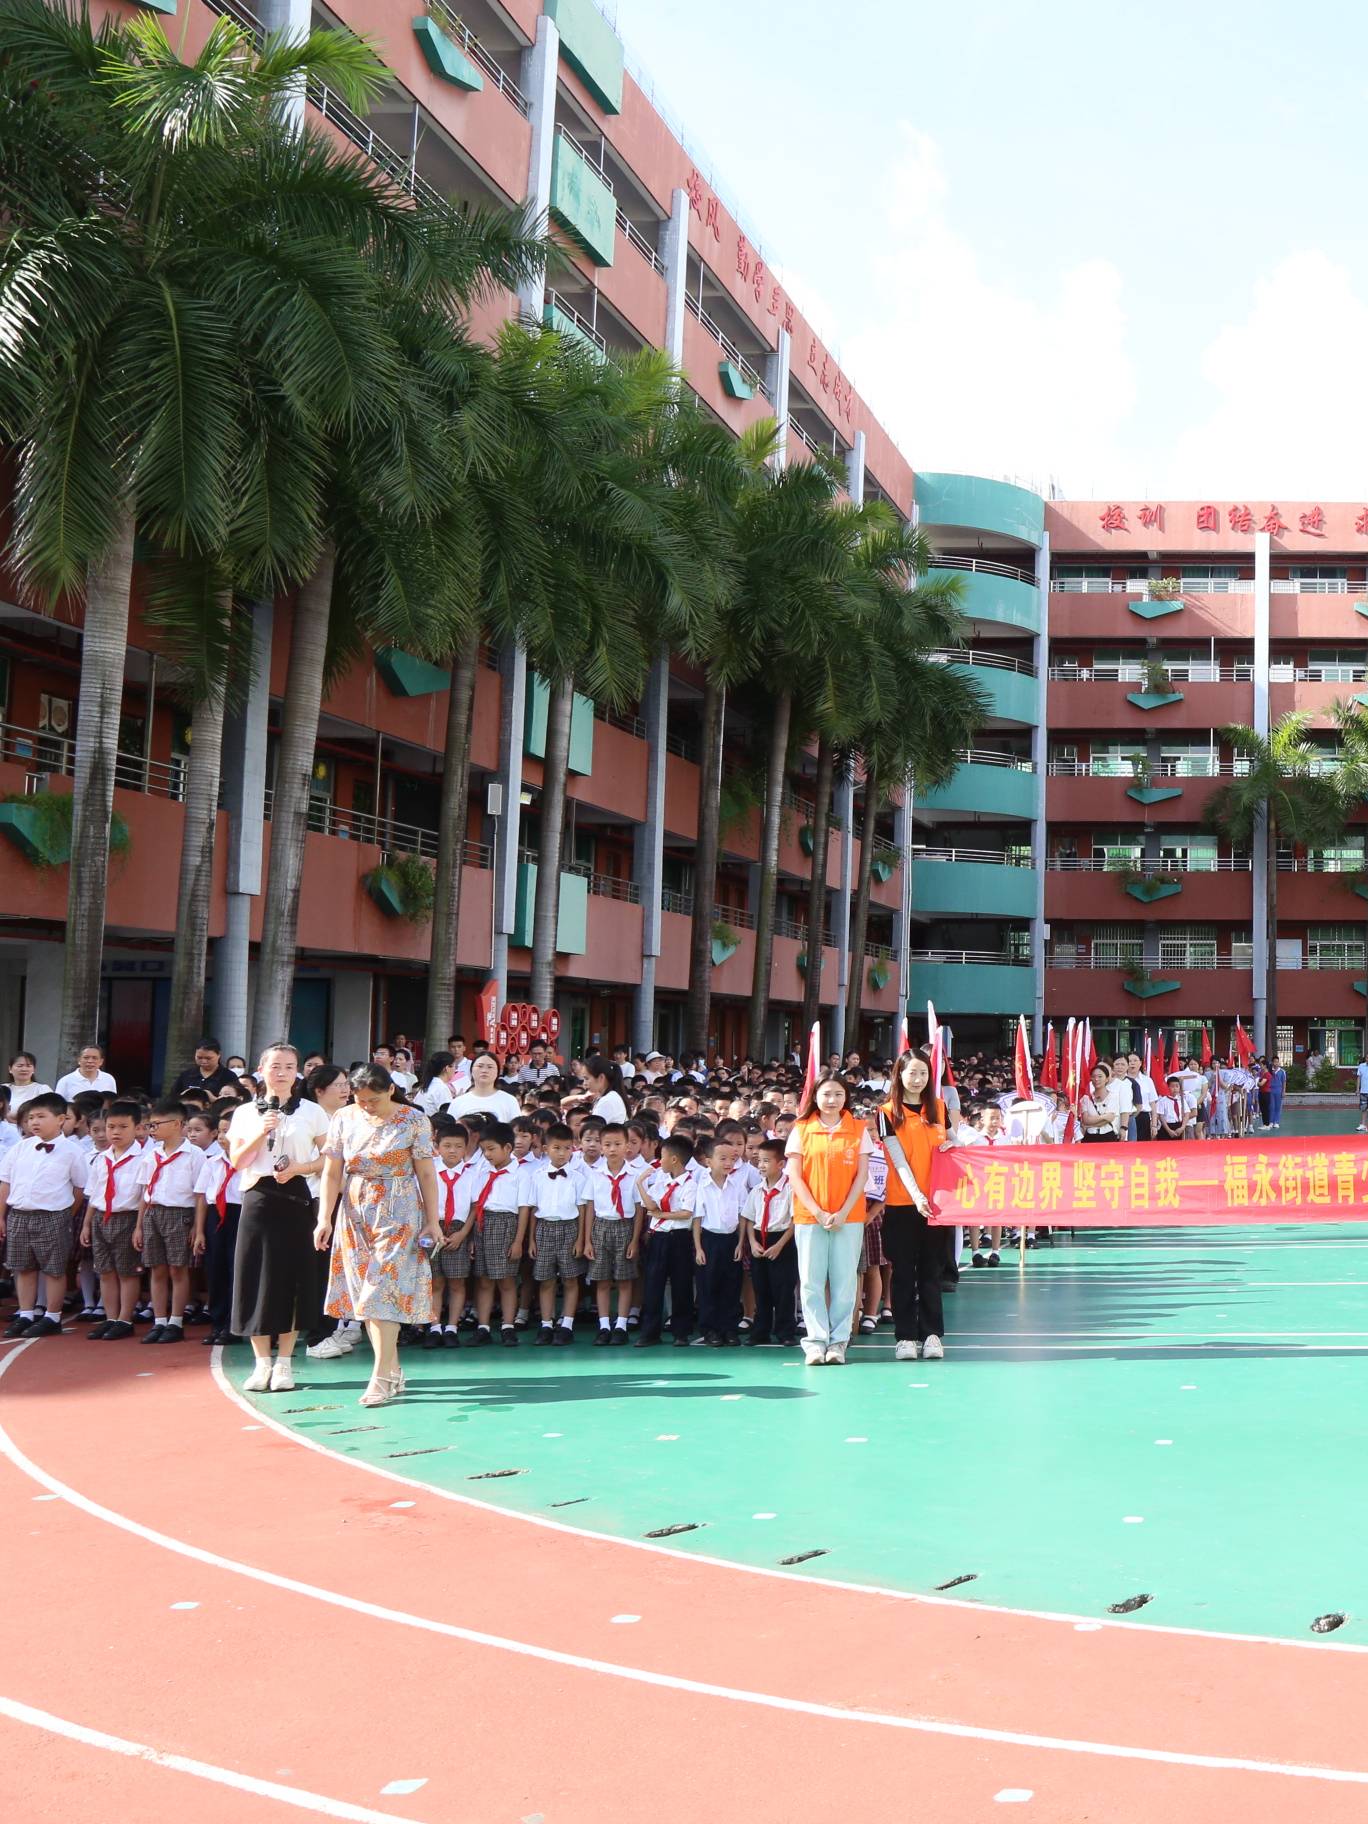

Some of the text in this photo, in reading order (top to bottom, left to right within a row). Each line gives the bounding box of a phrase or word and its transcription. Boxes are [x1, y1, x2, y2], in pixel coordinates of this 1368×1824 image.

[1098, 503, 1165, 533] 校训
[1196, 504, 1328, 538] 团结奋进
[955, 1160, 1062, 1210] 心有边界
